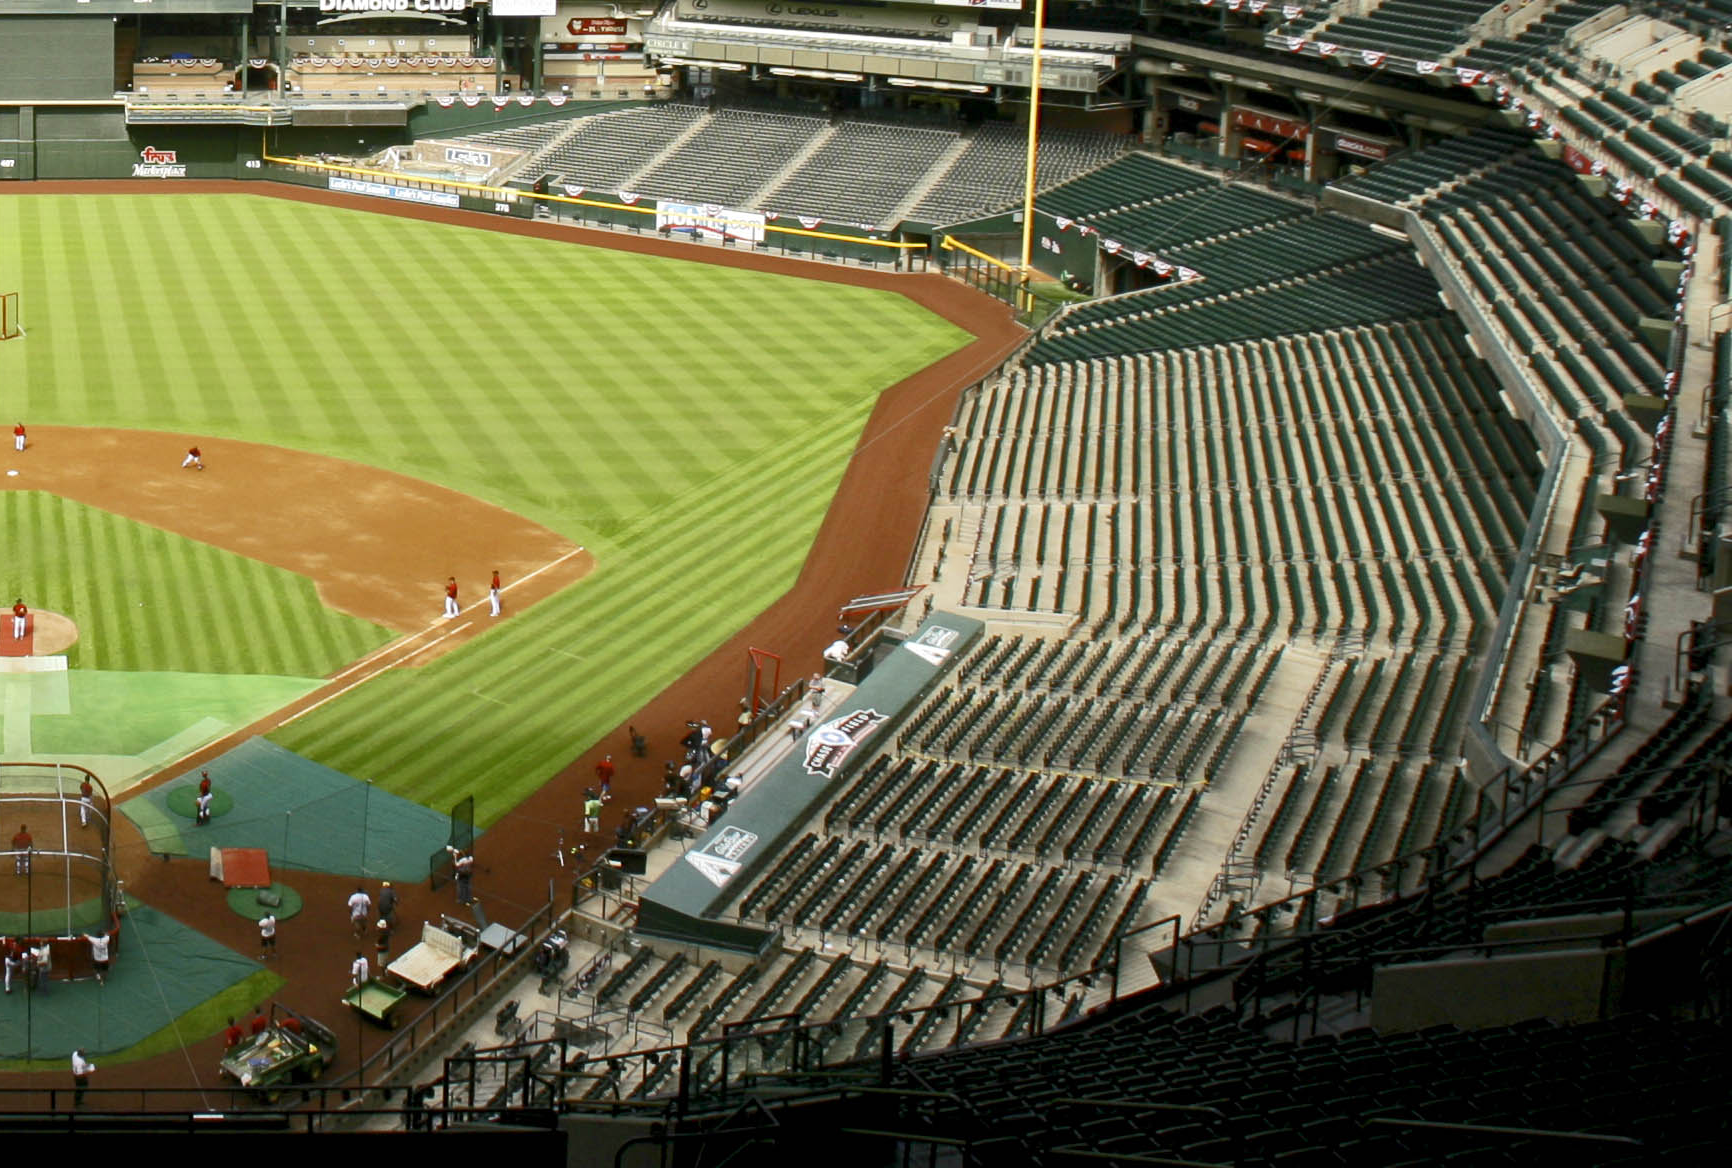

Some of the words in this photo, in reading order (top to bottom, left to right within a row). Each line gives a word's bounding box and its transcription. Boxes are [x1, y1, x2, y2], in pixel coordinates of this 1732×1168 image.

[787, 7, 839, 18] LEXUS
[646, 38, 681, 49] CIRCLE
[840, 714, 869, 733] FIELD
